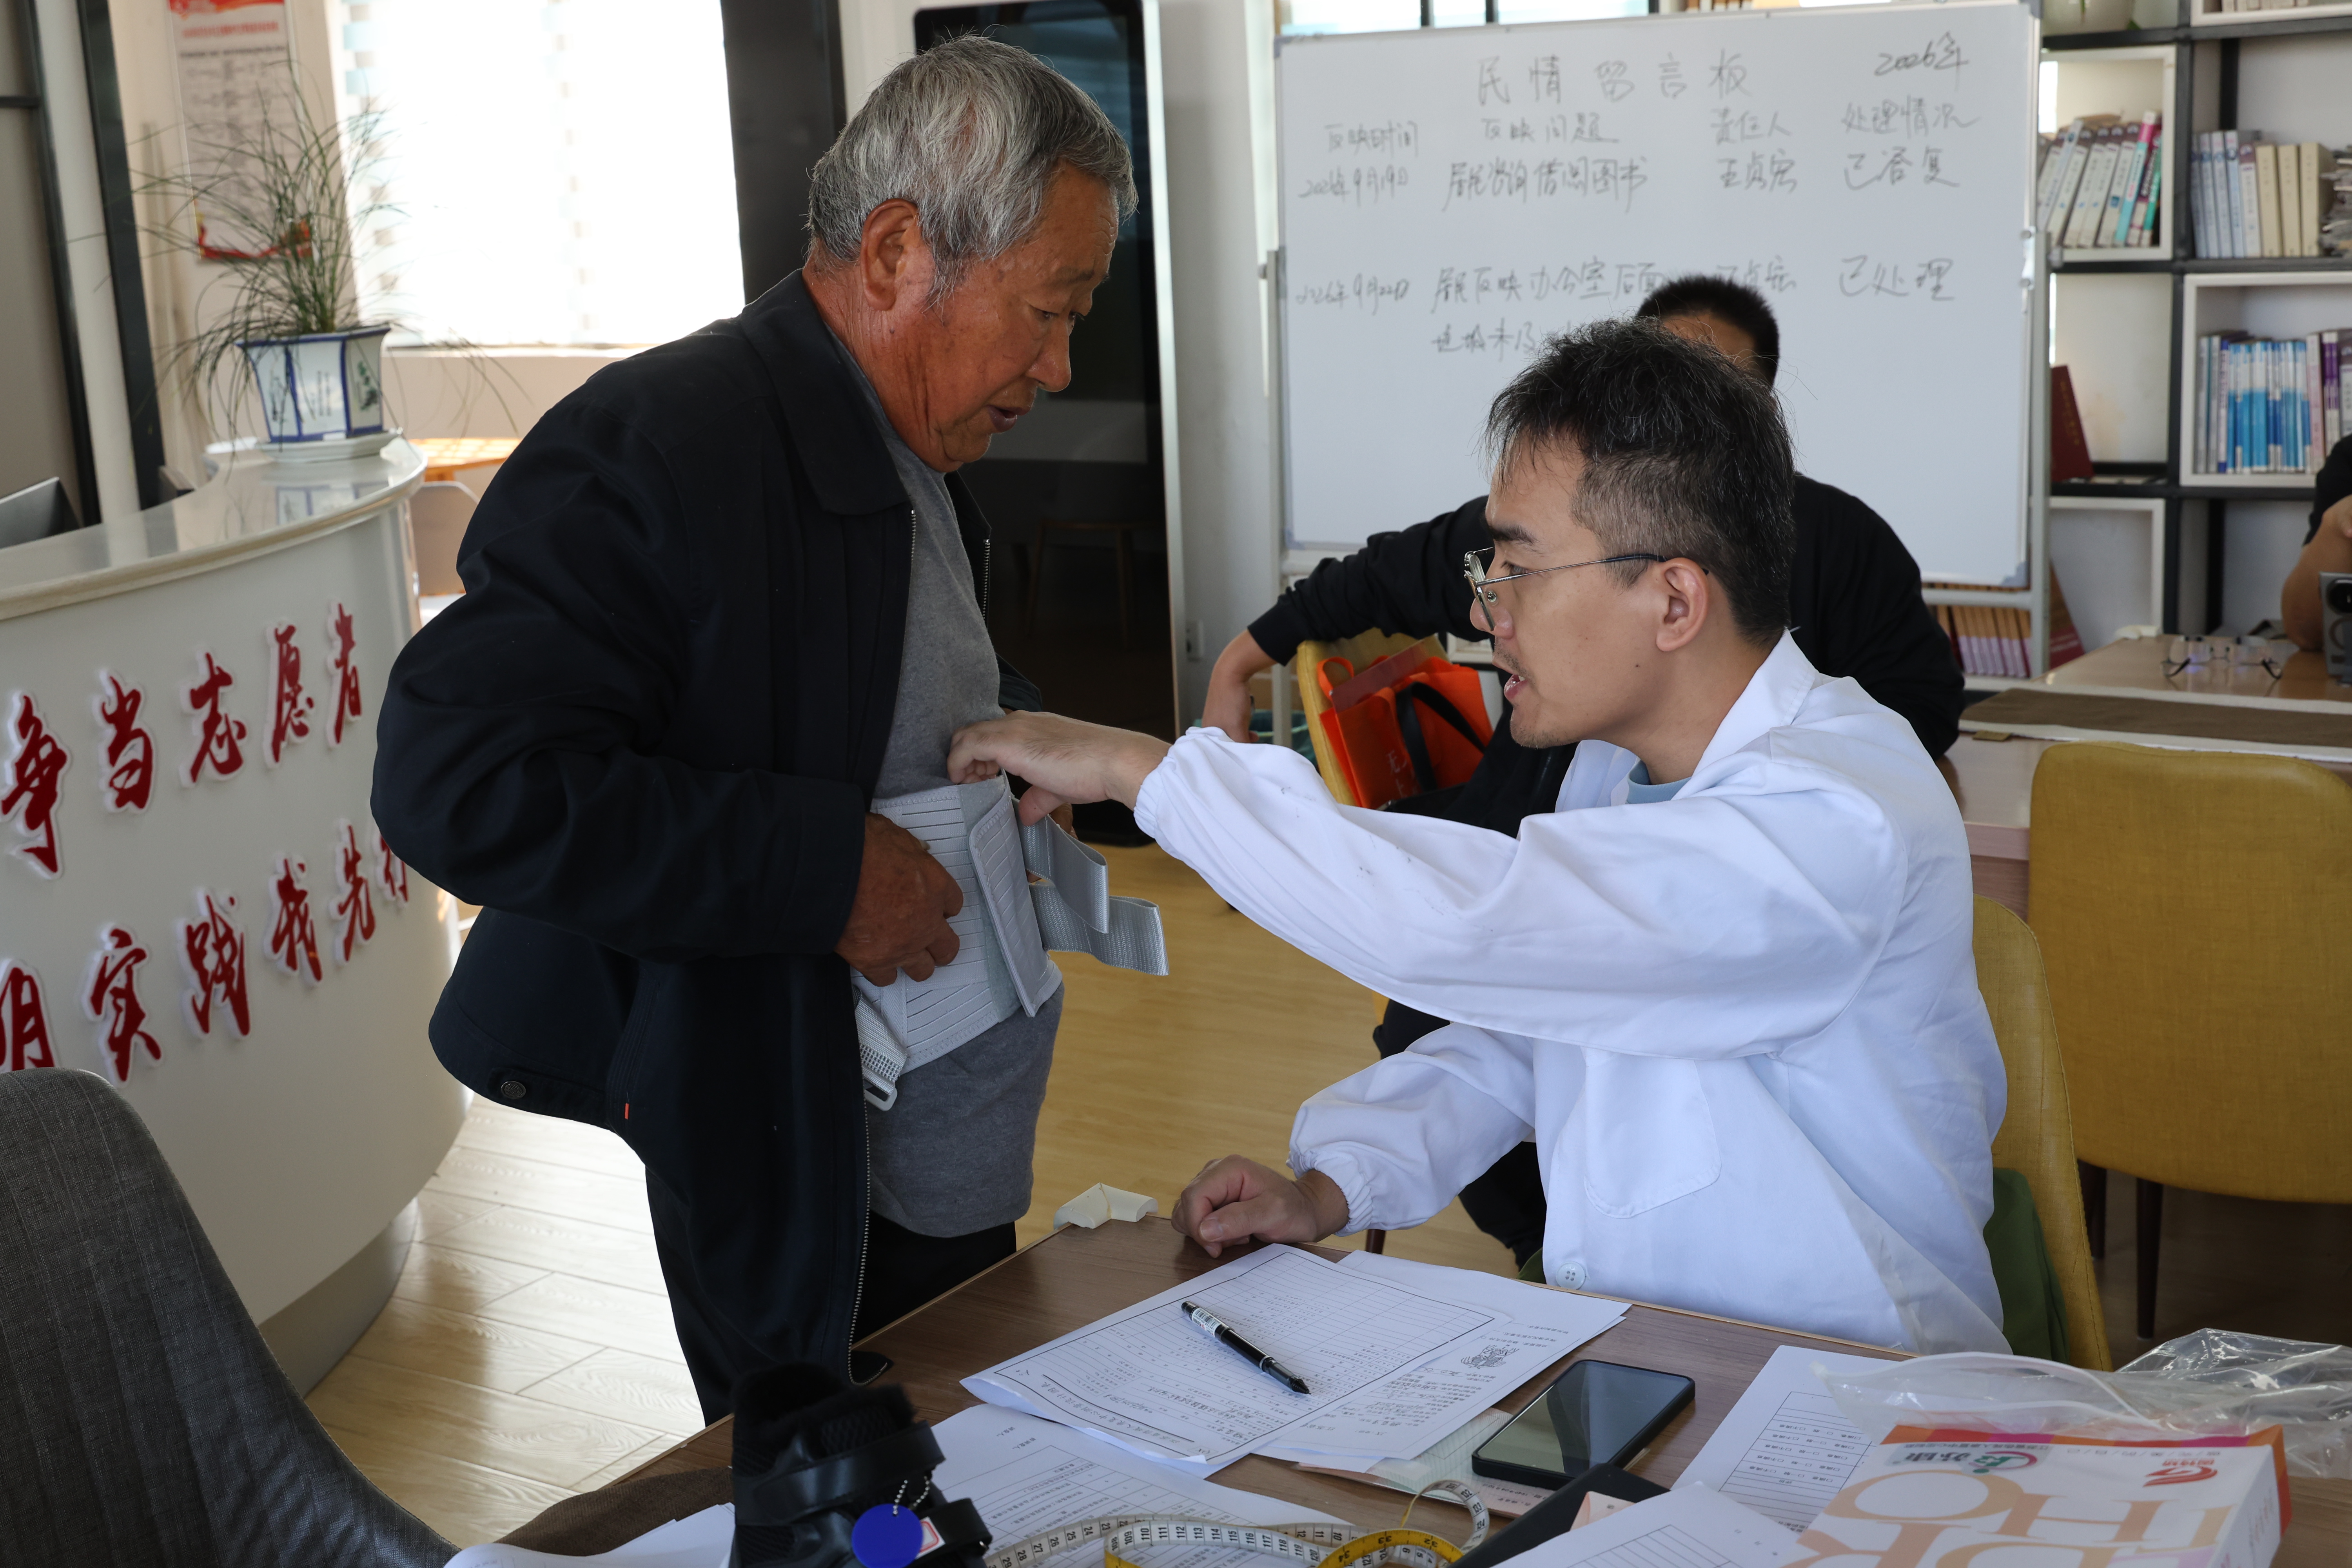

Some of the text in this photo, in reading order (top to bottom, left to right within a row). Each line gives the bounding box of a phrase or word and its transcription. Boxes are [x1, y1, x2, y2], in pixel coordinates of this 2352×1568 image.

[1478, 48, 1753, 105] 民情留言板
[1842, 94, 1982, 139] 处理情况
[1481, 112, 1620, 144] 反映问题
[1710, 108, 1792, 145] 责任人
[1839, 255, 1955, 301] 已处理
[0, 602, 363, 875] 争当志愿者
[1067, 1531, 1076, 1541] 25
[1083, 1526, 1093, 1536] 24
[1141, 1528, 1150, 1541] 110
[1159, 1527, 1167, 1539] 111
[1176, 1526, 1185, 1539] 112
[1194, 1527, 1203, 1540] 113
[1212, 1528, 1220, 1541] 114
[1229, 1530, 1238, 1542] 115
[1333, 1532, 1342, 1541] 10
[1050, 1537, 1059, 1546] 26
[1124, 1531, 1132, 1545] 109
[1246, 1532, 1255, 1545] 116
[1262, 1535, 1271, 1548] 117
[1033, 1543, 1043, 1553] 27
[1279, 1539, 1287, 1551] 118
[1294, 1544, 1303, 1556] 119
[1017, 1550, 1027, 1561] 28
[1310, 1549, 1319, 1562] 120
[1002, 1557, 1012, 1568] 29
